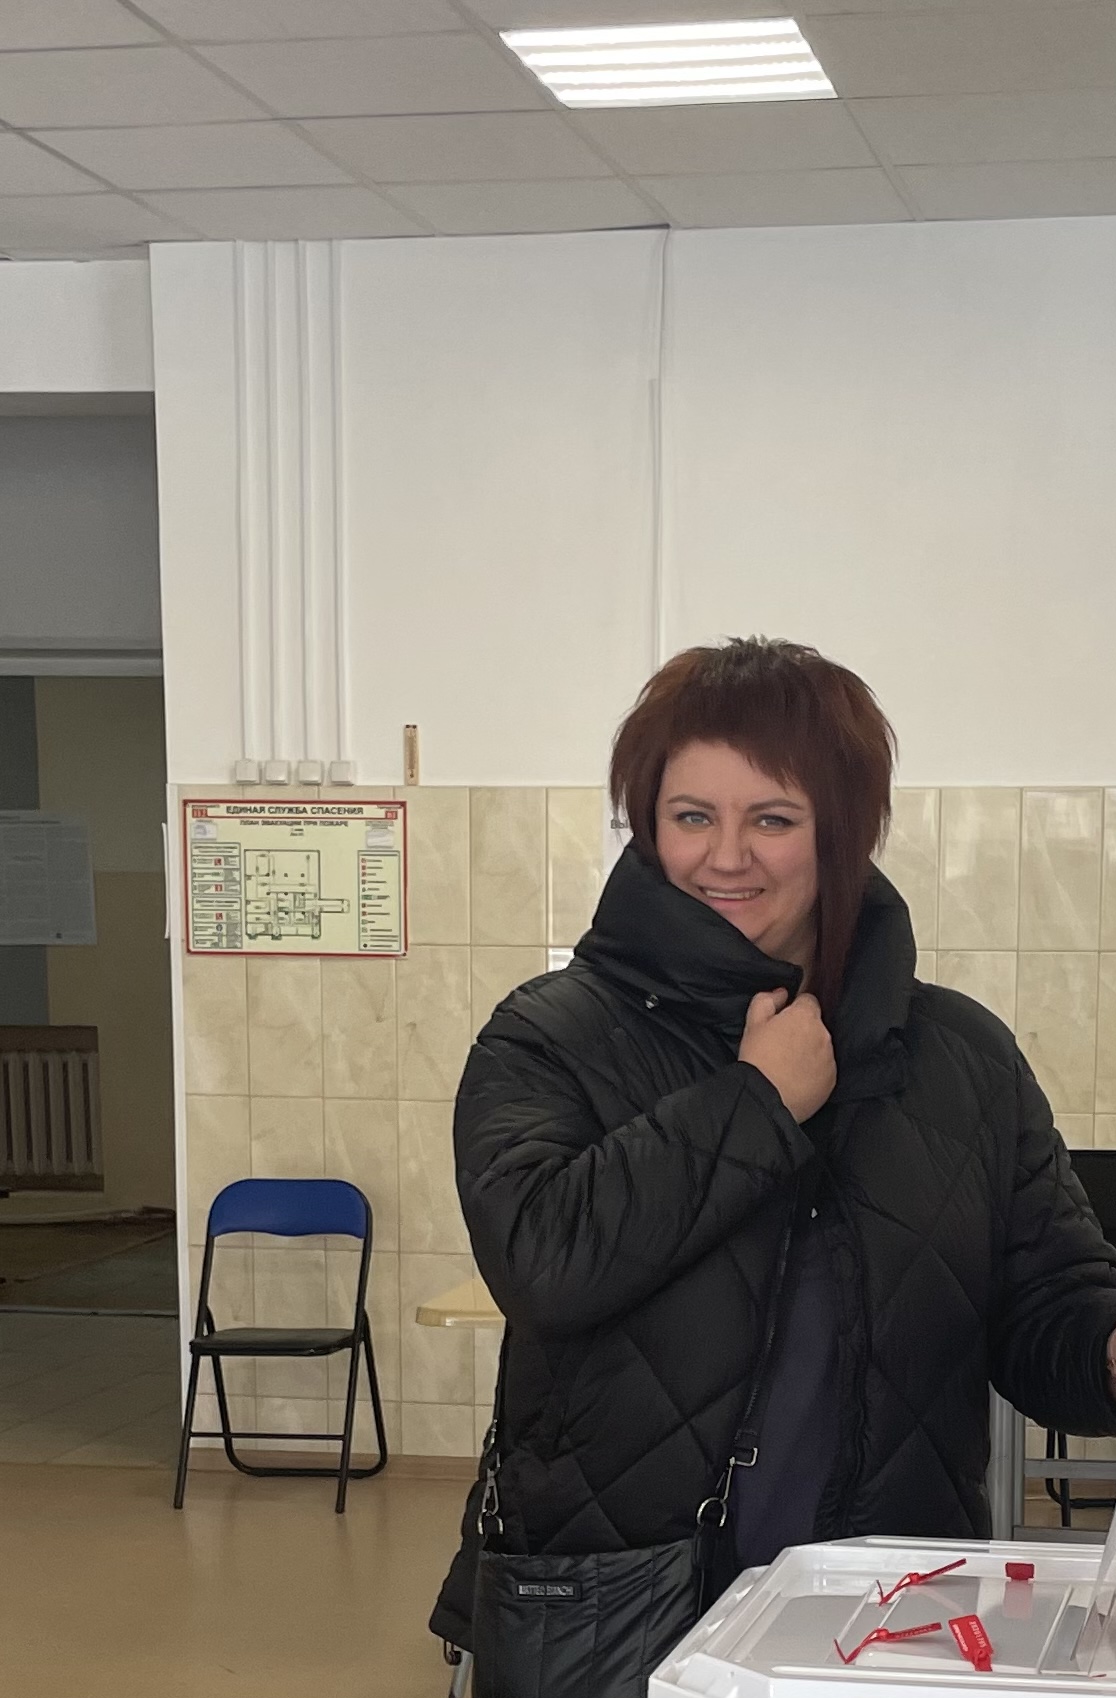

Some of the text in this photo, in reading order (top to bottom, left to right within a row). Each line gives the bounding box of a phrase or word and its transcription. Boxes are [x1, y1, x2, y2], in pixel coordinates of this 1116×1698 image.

[226, 805, 364, 815] ЕДИНАЯ СЛУЖБА СПАСЕНИЯ
